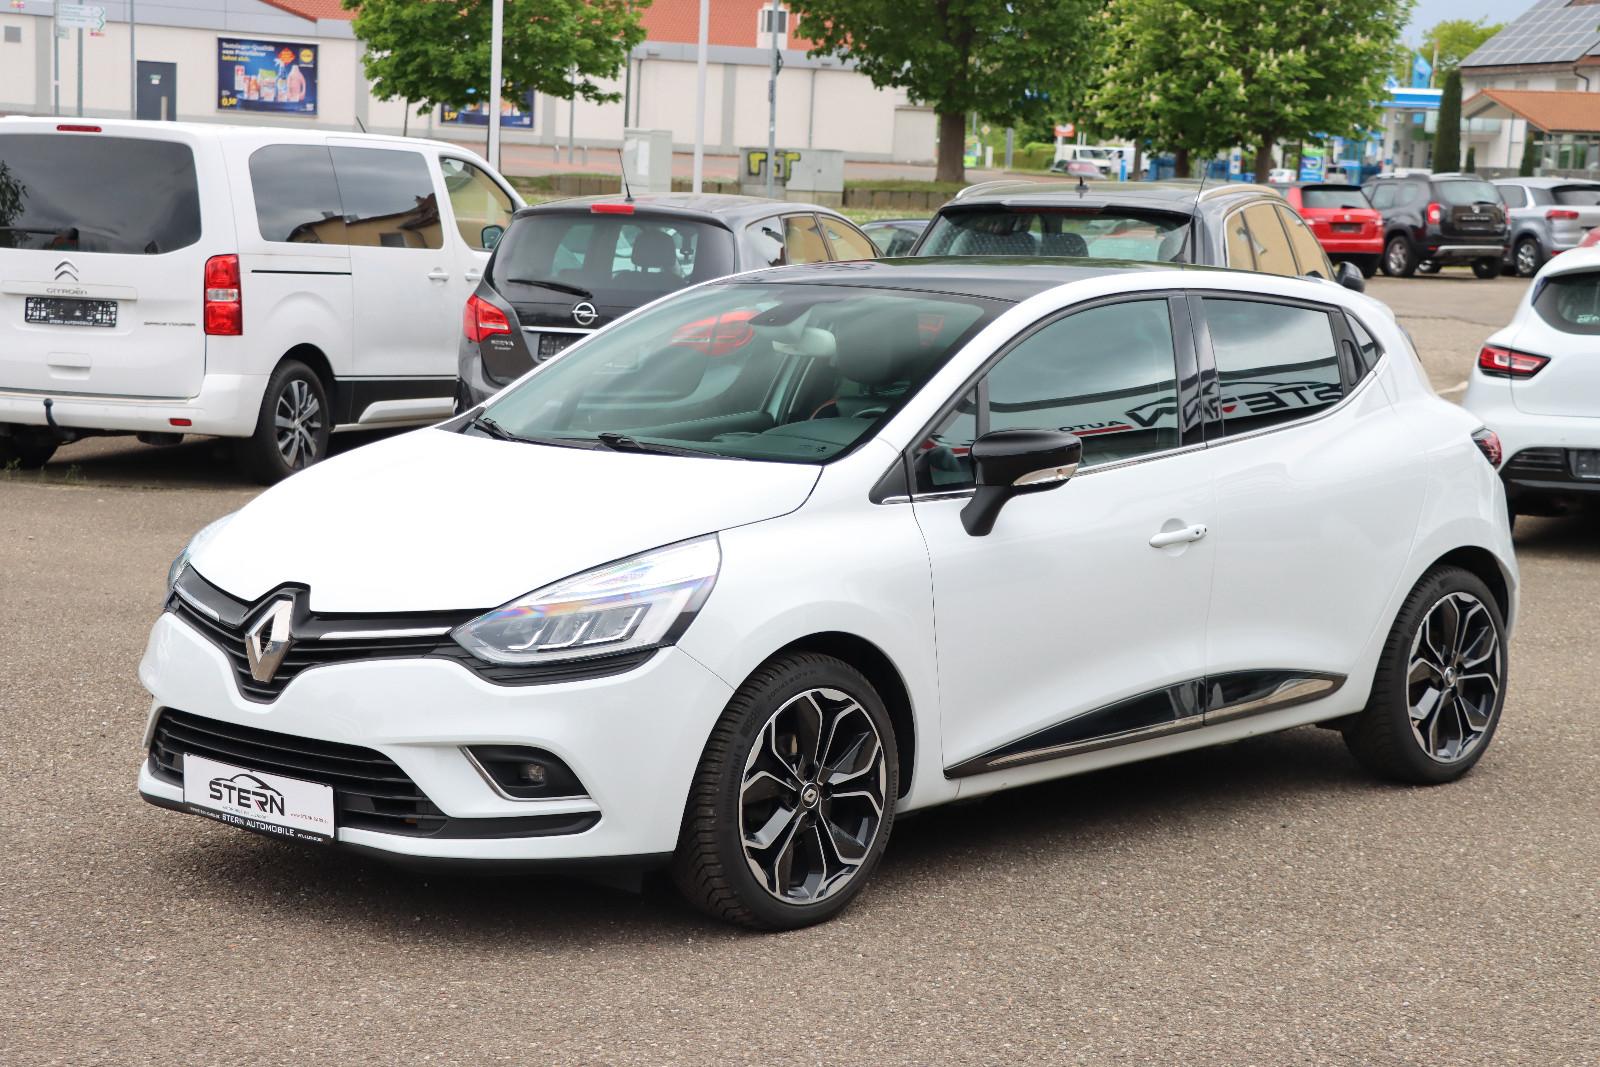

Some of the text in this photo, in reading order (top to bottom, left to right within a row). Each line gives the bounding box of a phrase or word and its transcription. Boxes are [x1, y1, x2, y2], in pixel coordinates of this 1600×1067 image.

[209, 779, 285, 816] STERN
[222, 813, 245, 827] STERN
[246, 819, 295, 837] AUTOMOBILE
